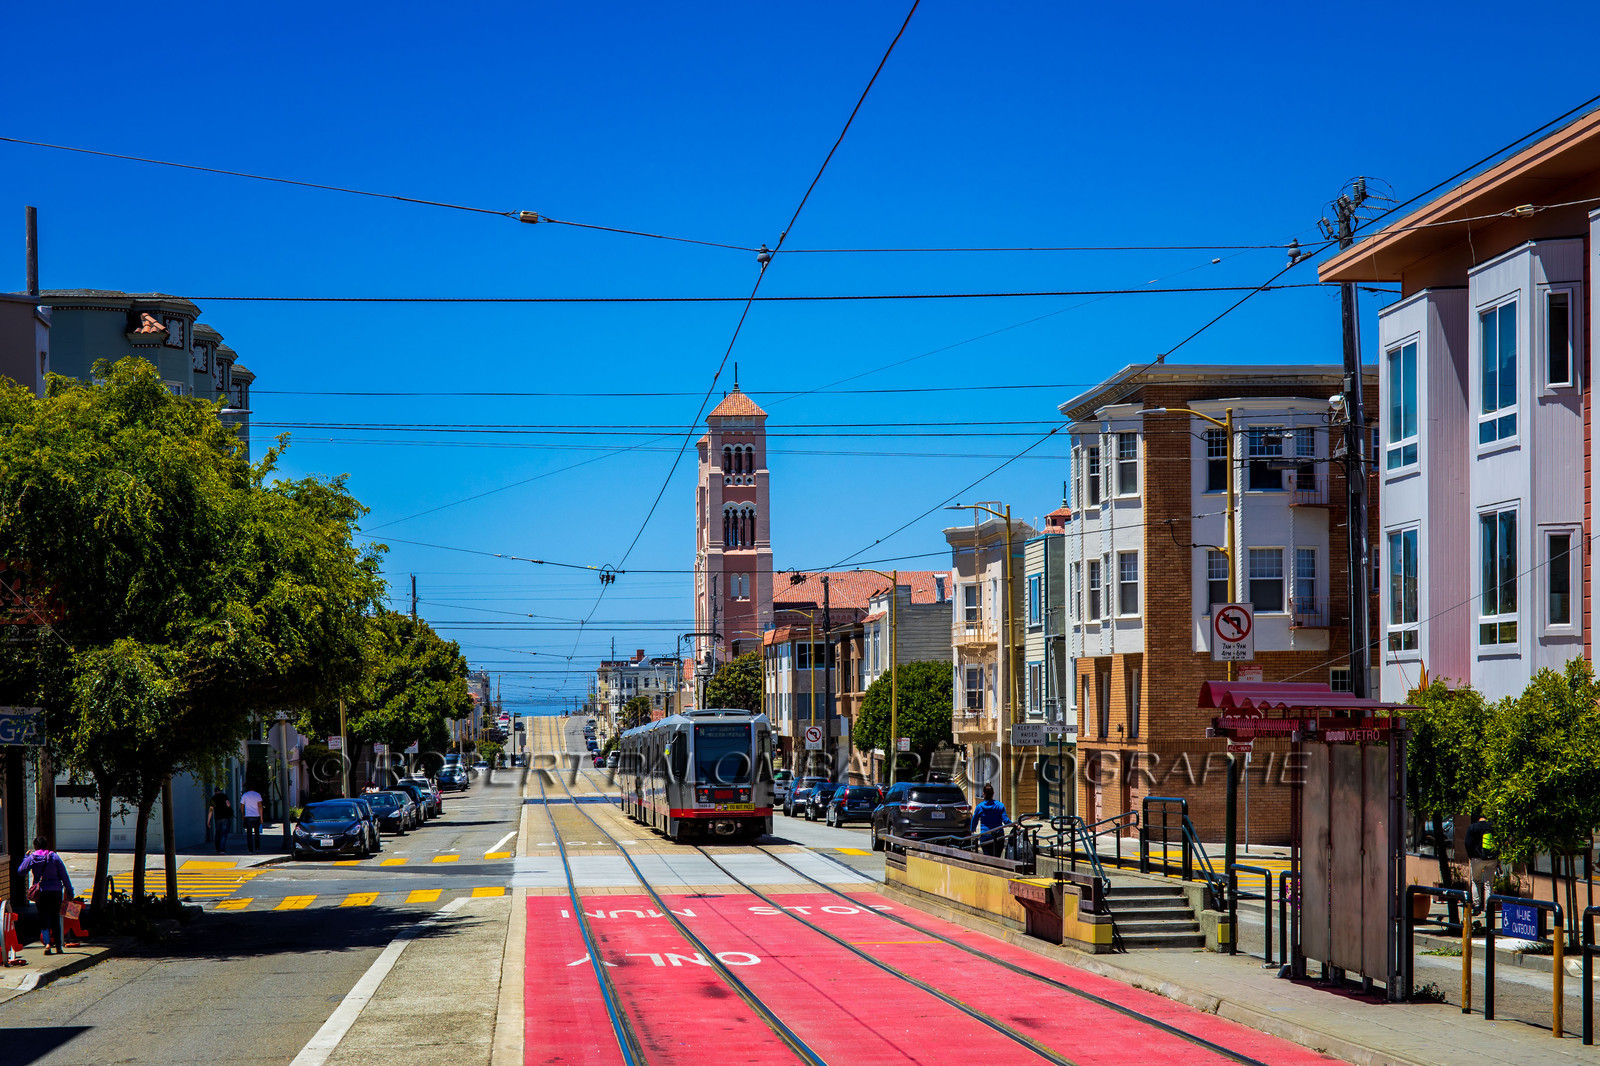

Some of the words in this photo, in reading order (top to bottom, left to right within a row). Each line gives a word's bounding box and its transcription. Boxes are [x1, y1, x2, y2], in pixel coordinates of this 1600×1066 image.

[1346, 730, 1380, 741] METRO
[560, 908, 697, 919] MUNI
[748, 905, 894, 915] STOP
[1516, 909, 1531, 921] N-LINE
[1511, 922, 1536, 936] OUTBOUND
[566, 951, 762, 967] ONLY
